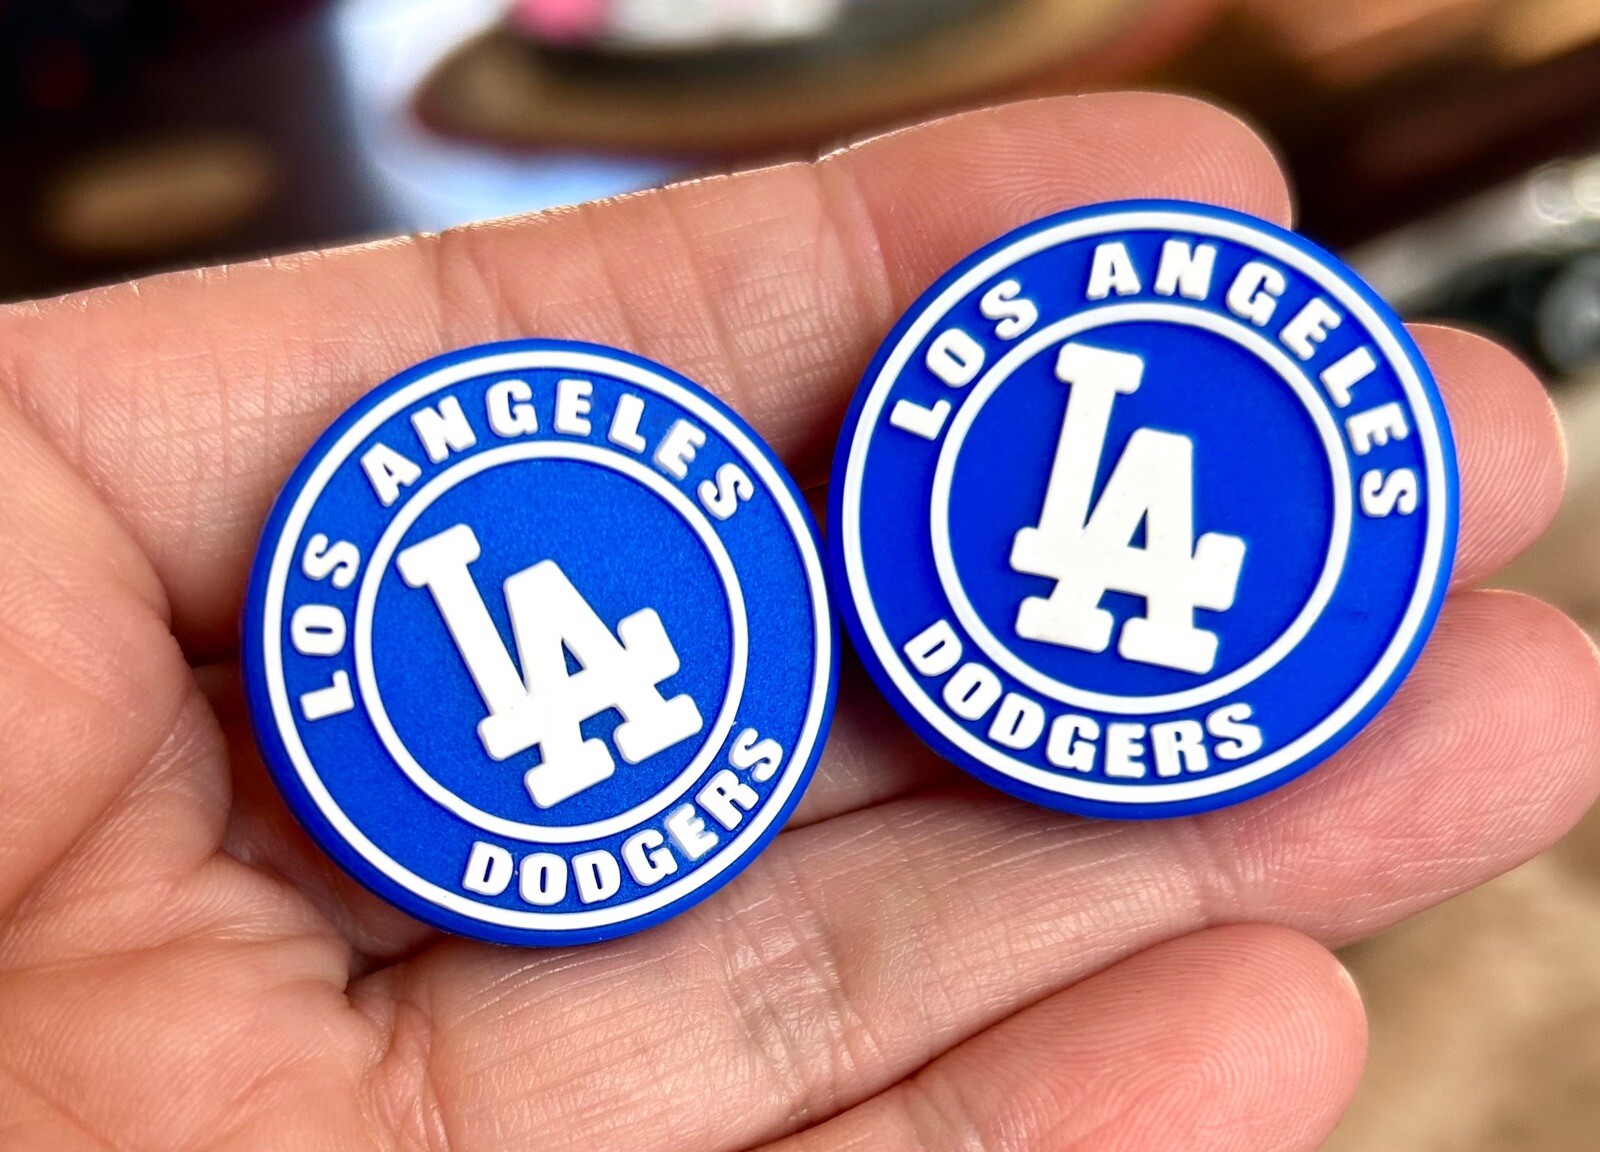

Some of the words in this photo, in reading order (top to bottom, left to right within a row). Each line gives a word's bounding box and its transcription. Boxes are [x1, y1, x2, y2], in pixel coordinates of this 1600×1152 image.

[890, 279, 1039, 441] LOS
[1086, 240, 1418, 518] ANGELES
[1009, 342, 1246, 674] LA
[291, 533, 361, 721] LOS
[361, 378, 755, 520] ANGELES
[396, 524, 704, 809] LA
[463, 727, 785, 906] DODGERS
[904, 619, 1264, 778] DODGERS
